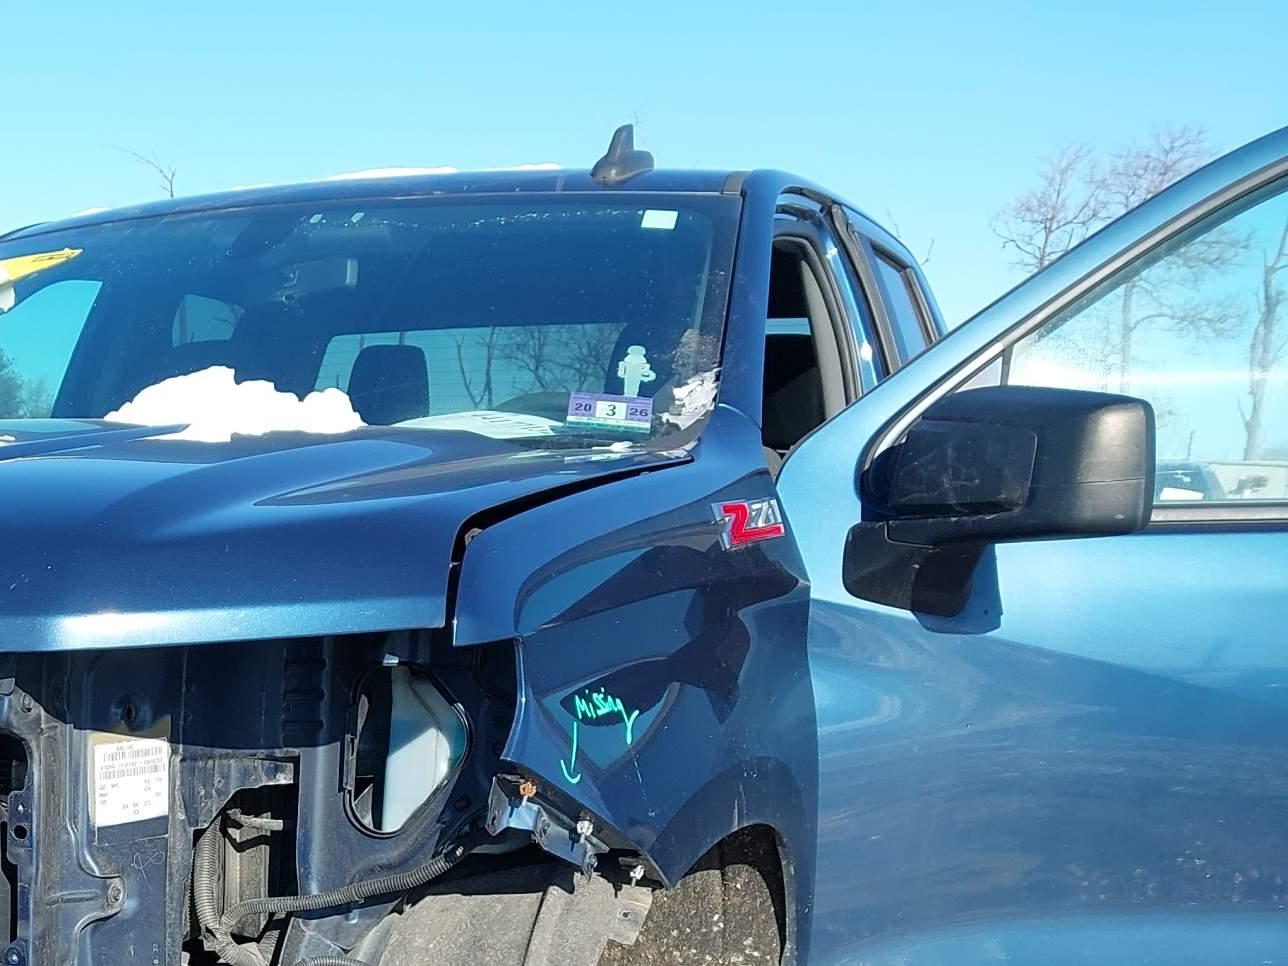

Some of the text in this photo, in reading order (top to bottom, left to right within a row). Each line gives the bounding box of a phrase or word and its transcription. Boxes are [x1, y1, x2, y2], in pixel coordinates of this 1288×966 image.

[574, 402, 649, 417] 20 3 26
[710, 497, 786, 551] Z71
